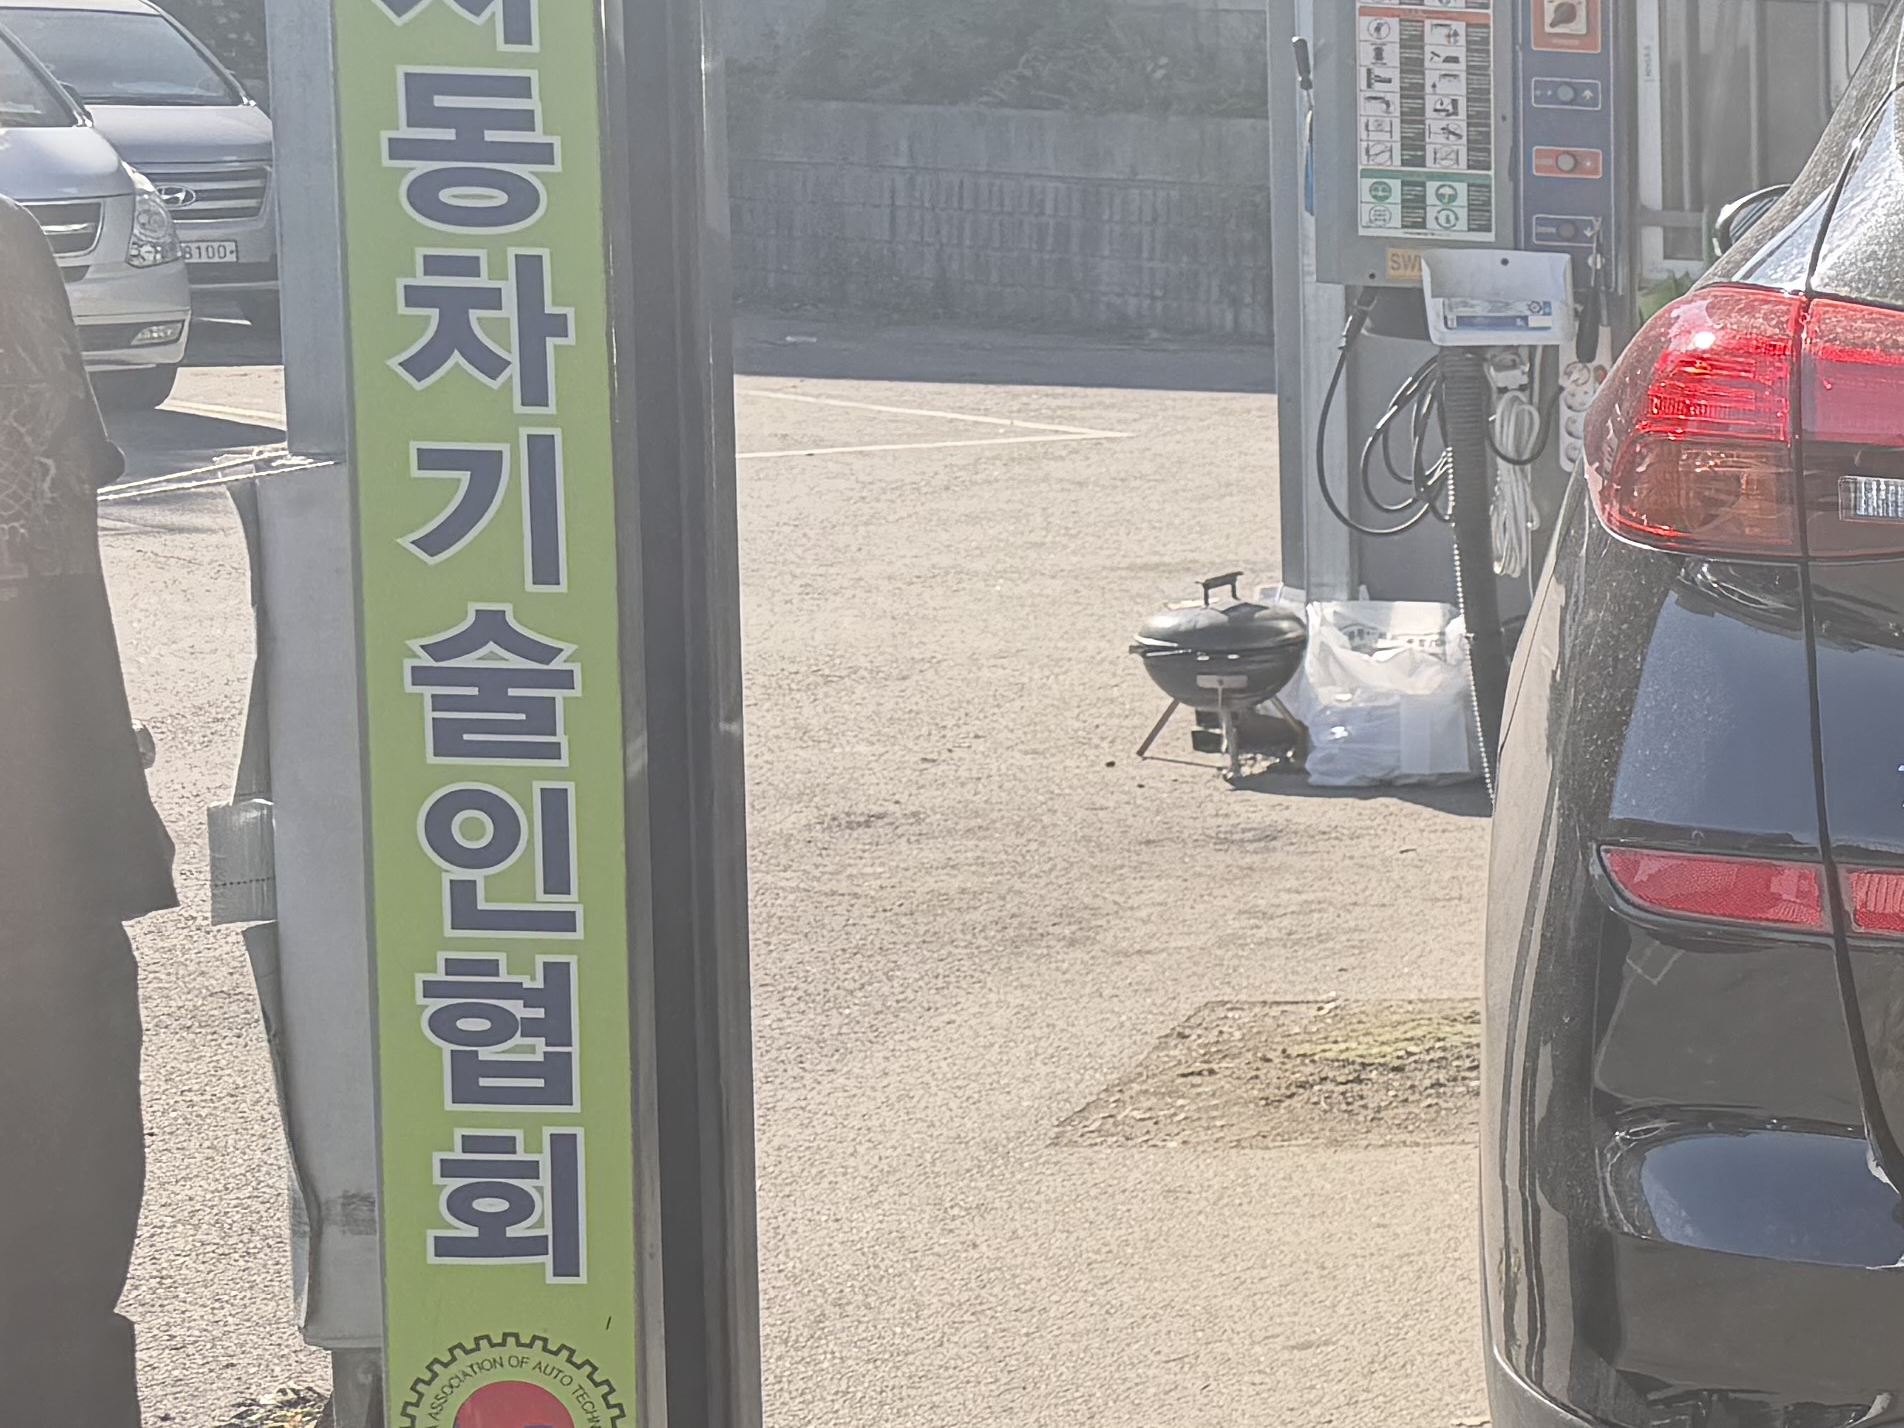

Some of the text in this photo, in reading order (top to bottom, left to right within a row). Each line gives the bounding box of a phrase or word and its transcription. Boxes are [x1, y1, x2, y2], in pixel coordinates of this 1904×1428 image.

[428, 1356, 504, 1421] ASSOCIATION
[508, 1355, 530, 1368] OF
[532, 1360, 574, 1387] AUTO
